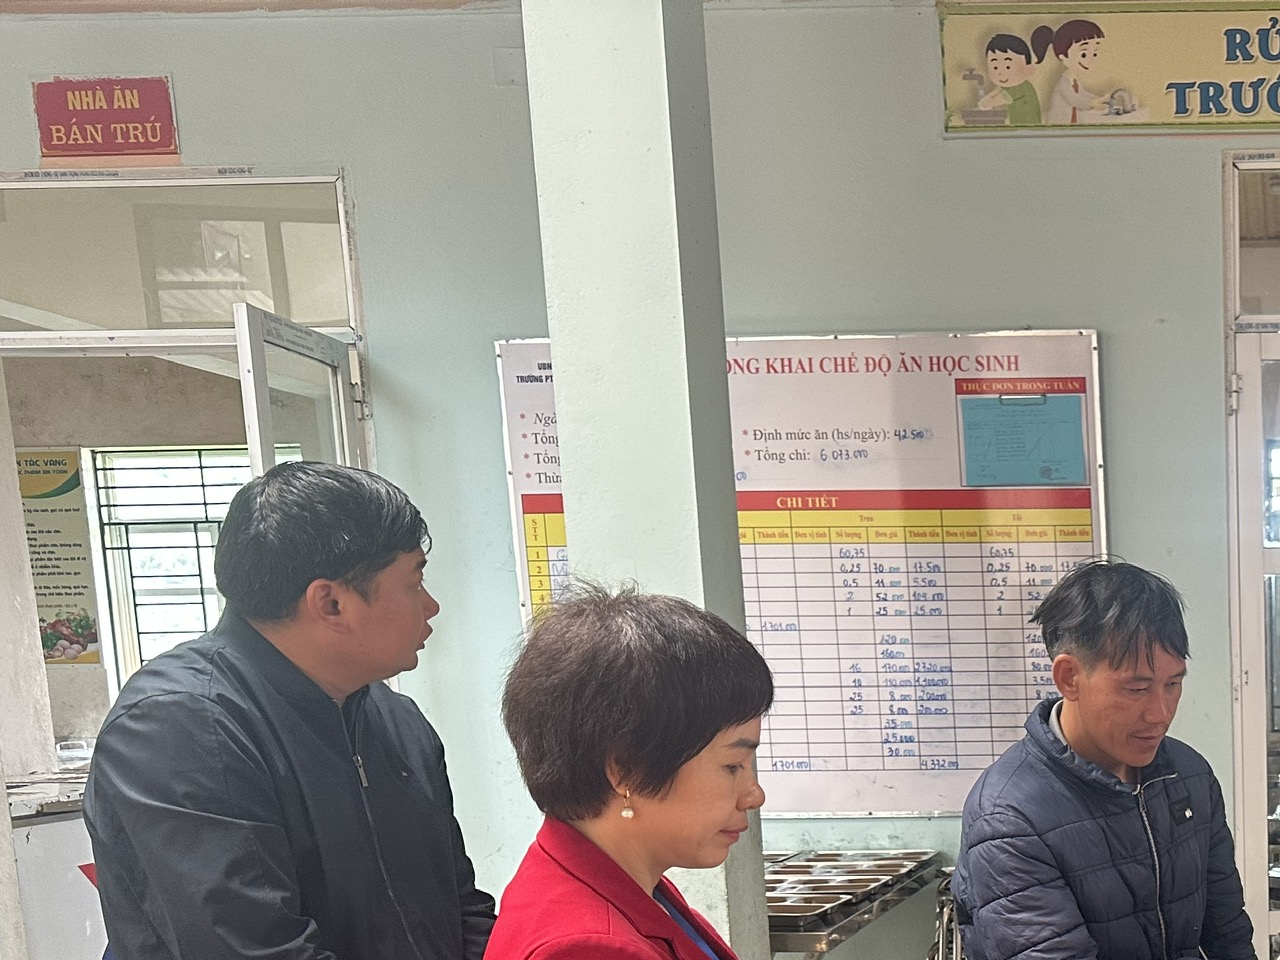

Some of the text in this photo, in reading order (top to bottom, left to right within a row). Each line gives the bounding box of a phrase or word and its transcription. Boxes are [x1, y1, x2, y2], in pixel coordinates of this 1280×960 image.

[66, 84, 140, 111] NHÀ ĂN
[50, 115, 162, 145] BÁN TRÚ
[538, 362, 552, 371] UBN
[727, 352, 1020, 377] NG KHAI CHẾ ĐỘ ĂN HỌC SINH
[545, 375, 554, 383] PT
[962, 381, 991, 392] THỰC
[1016, 380, 1050, 390] TRONG
[534, 413, 557, 428] Ngà
[753, 428, 890, 444] Định mức ăn (hs/ngày):
[755, 446, 786, 463] Tổng
[789, 449, 811, 461] chi:
[776, 494, 839, 510] CHI TIẾT
[535, 551, 540, 559] 1
[536, 566, 542, 574] 2
[537, 580, 543, 588] 3
[999, 591, 1005, 600] 2
